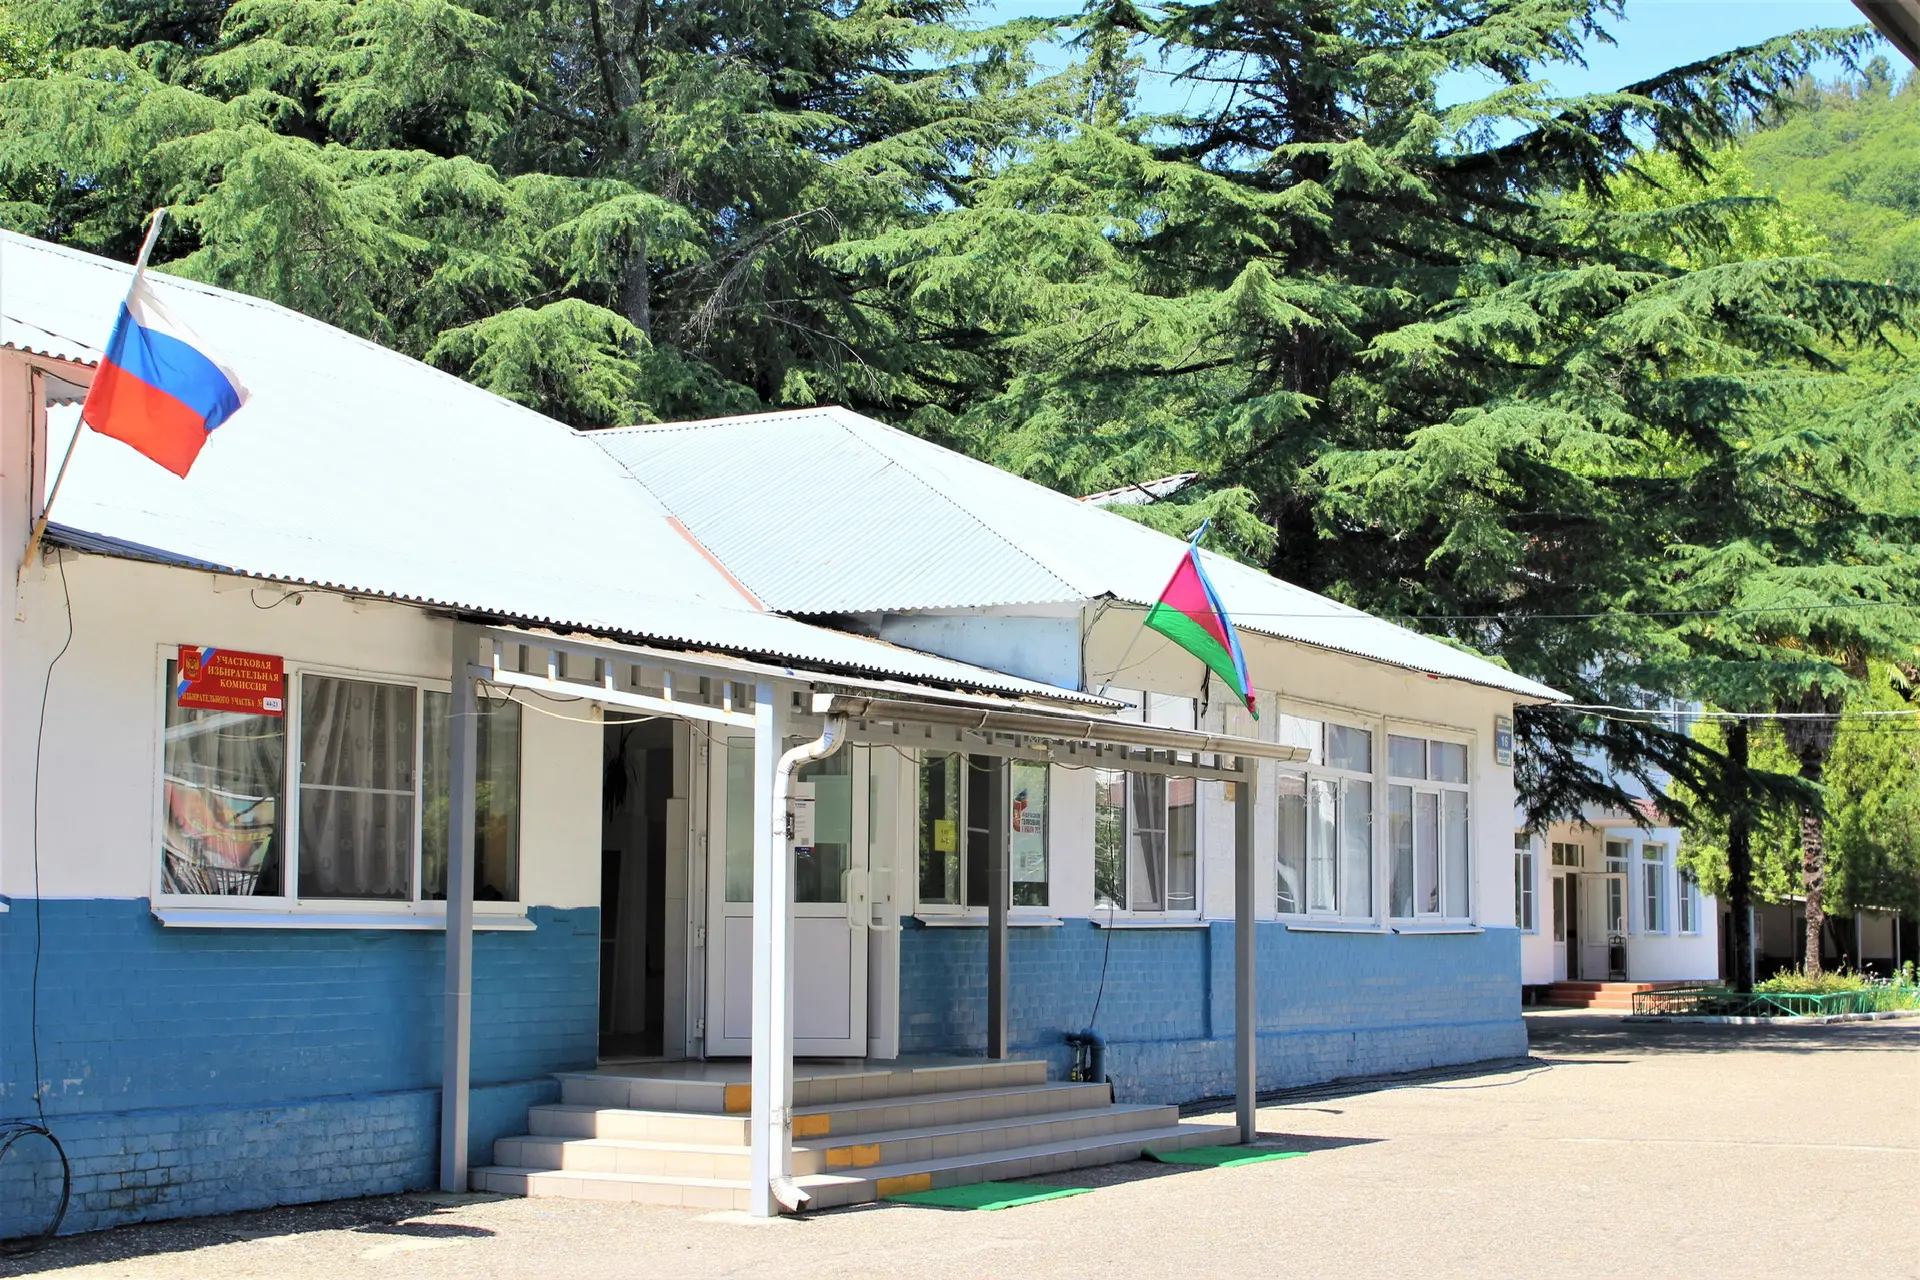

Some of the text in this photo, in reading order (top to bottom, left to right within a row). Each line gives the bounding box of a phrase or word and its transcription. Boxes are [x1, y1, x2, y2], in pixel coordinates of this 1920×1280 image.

[216, 655, 271, 670] УЧАСТКОВАЯ
[207, 665, 279, 682] ИЗБИРАТЕЛЬНАЯ
[220, 679, 267, 691] КОМИССИЯ
[231, 697, 255, 707] УЧАСТКА
[1501, 735, 1509, 748] 16
